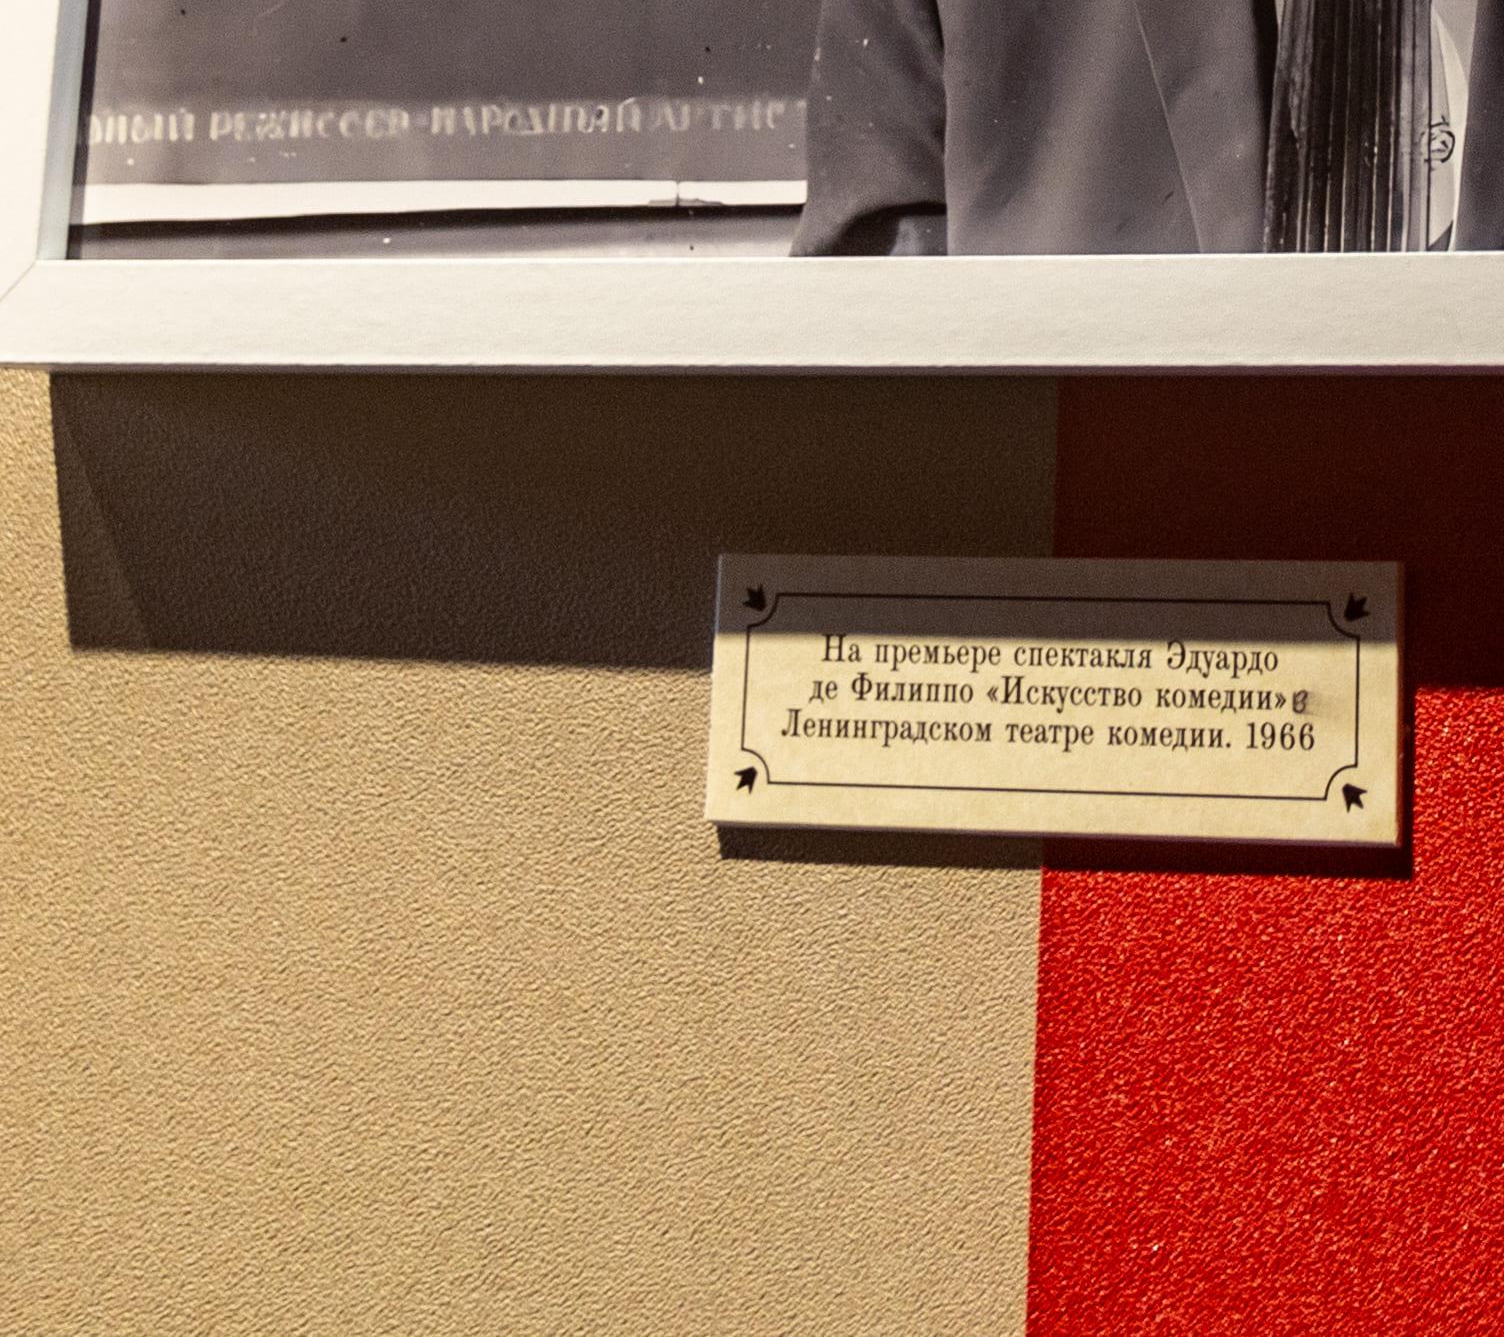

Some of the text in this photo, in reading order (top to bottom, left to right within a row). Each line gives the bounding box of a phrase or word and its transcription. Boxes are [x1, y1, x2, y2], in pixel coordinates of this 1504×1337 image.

[821, 633, 1279, 679] На премьере спектакля Эдуардо
[808, 679, 838, 703] де
[851, 671, 974, 703] Филиппо
[986, 675, 1142, 714] «Искусство
[1155, 687, 1287, 713] комедии»
[781, 708, 1315, 752] Ленинградском театре комедии. 1966
